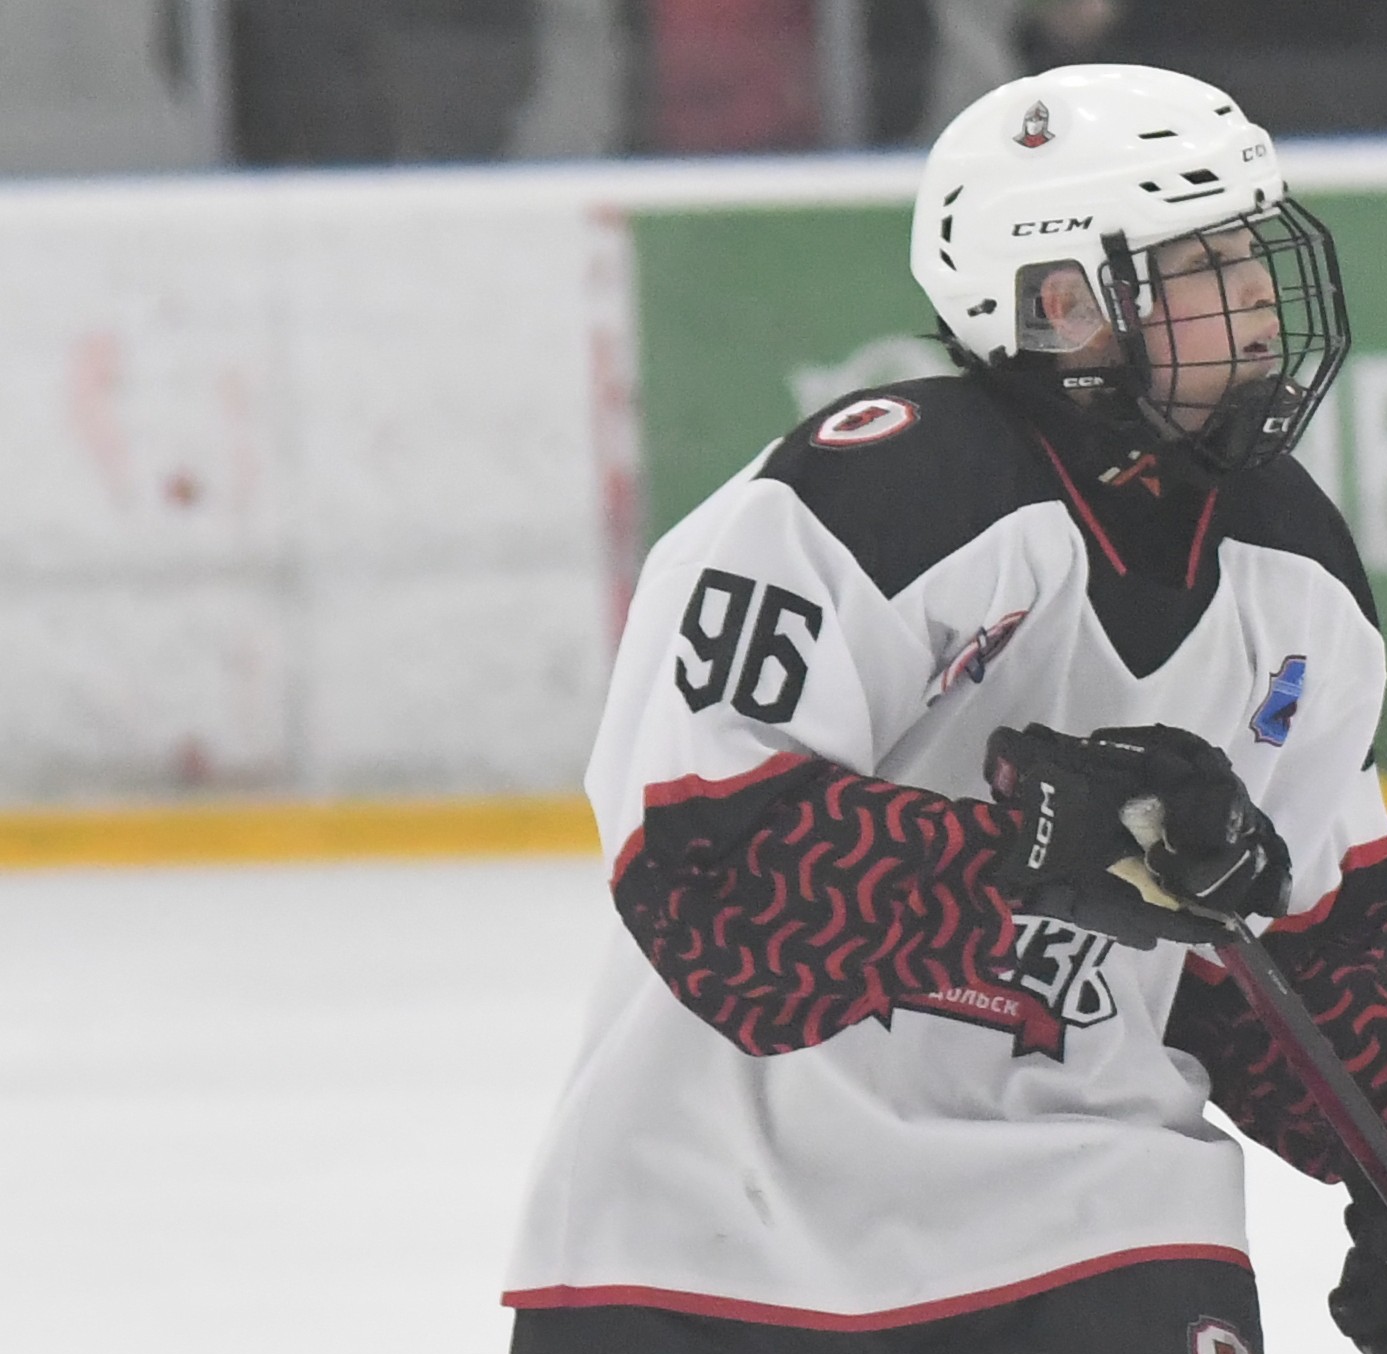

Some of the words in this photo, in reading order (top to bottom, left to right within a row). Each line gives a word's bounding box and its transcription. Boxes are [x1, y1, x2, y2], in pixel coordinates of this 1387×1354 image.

[1011, 215, 1094, 237] CCM
[675, 567, 823, 725] 96
[1027, 781, 1055, 870] CCM
